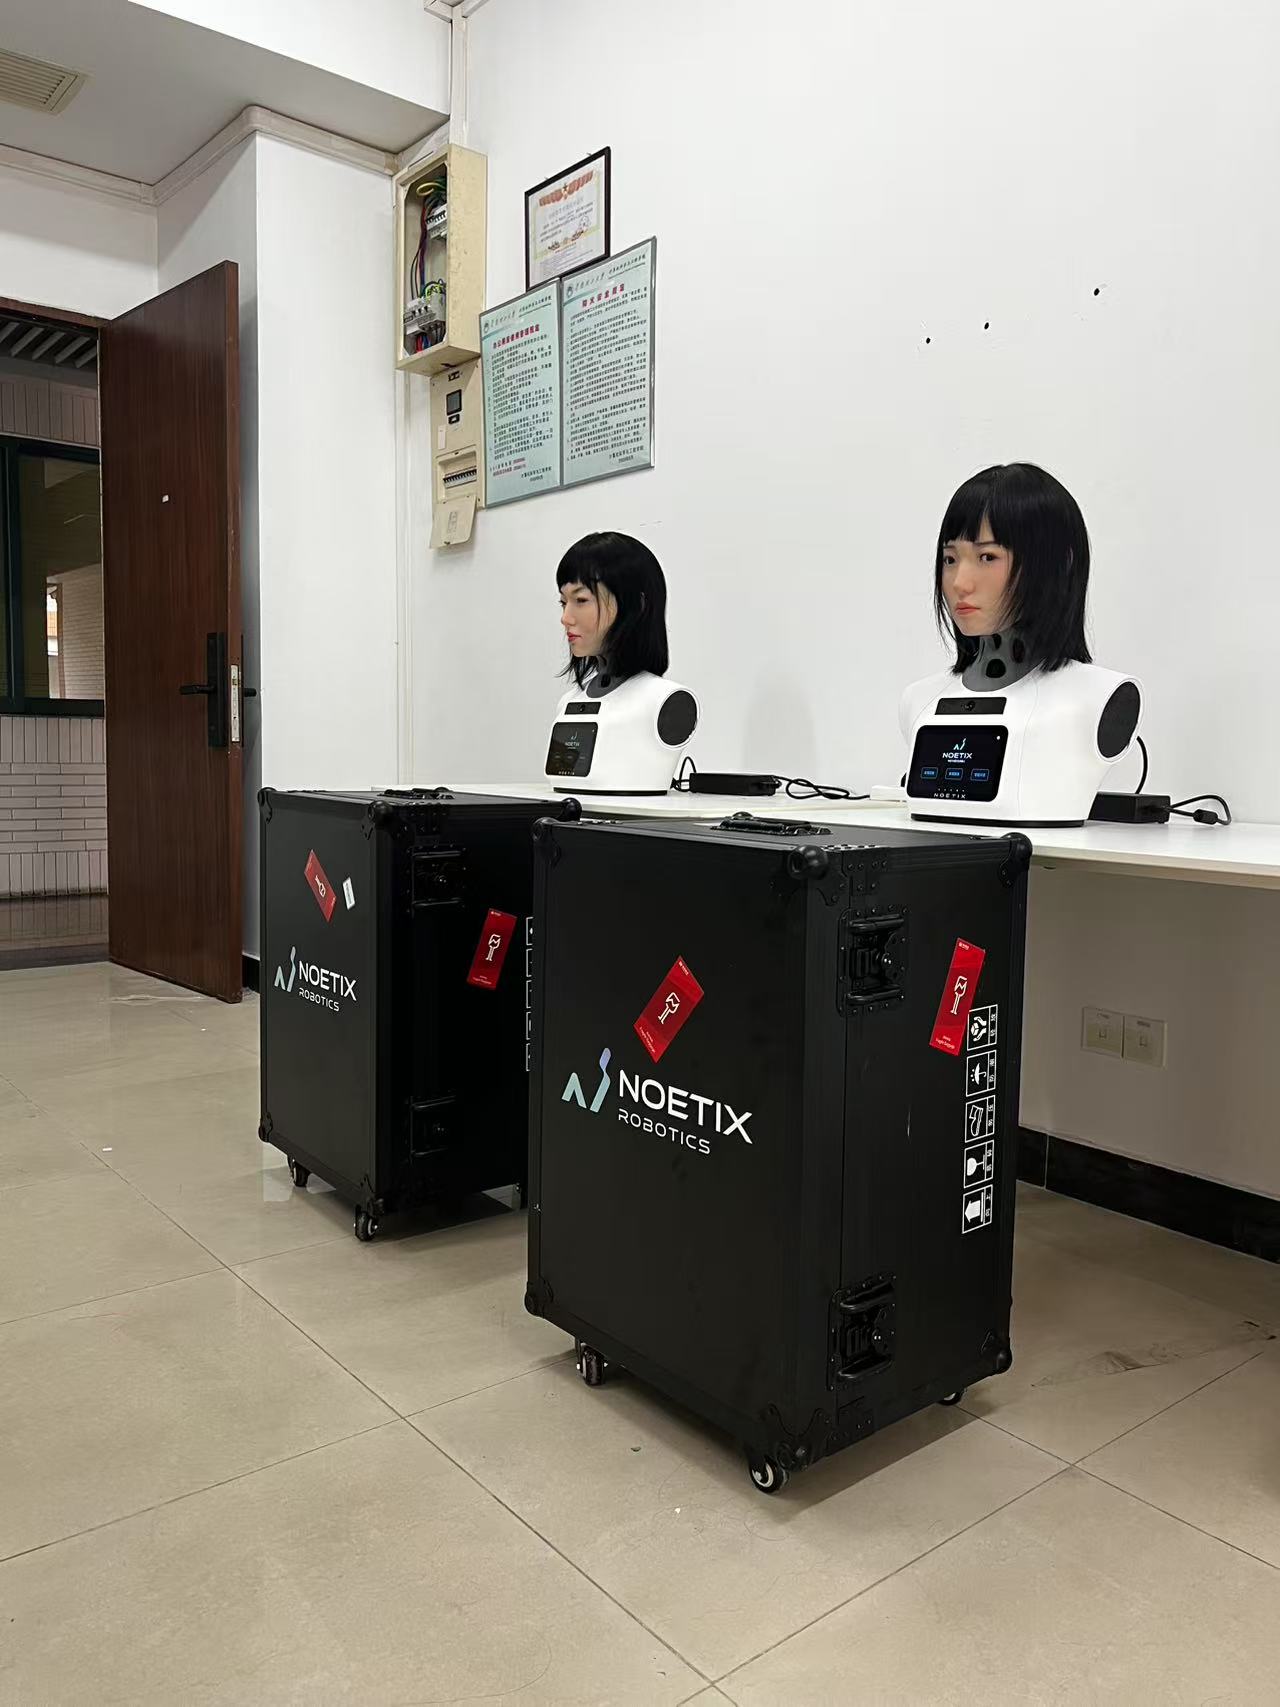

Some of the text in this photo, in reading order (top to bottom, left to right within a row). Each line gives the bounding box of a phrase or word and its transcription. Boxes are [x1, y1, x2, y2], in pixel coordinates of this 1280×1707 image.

[299, 960, 357, 1001] NOETIX
[299, 987, 340, 1012] ROBOTICS
[618, 1069, 753, 1145] NOETIX
[618, 1108, 711, 1155] ROBOTICS
